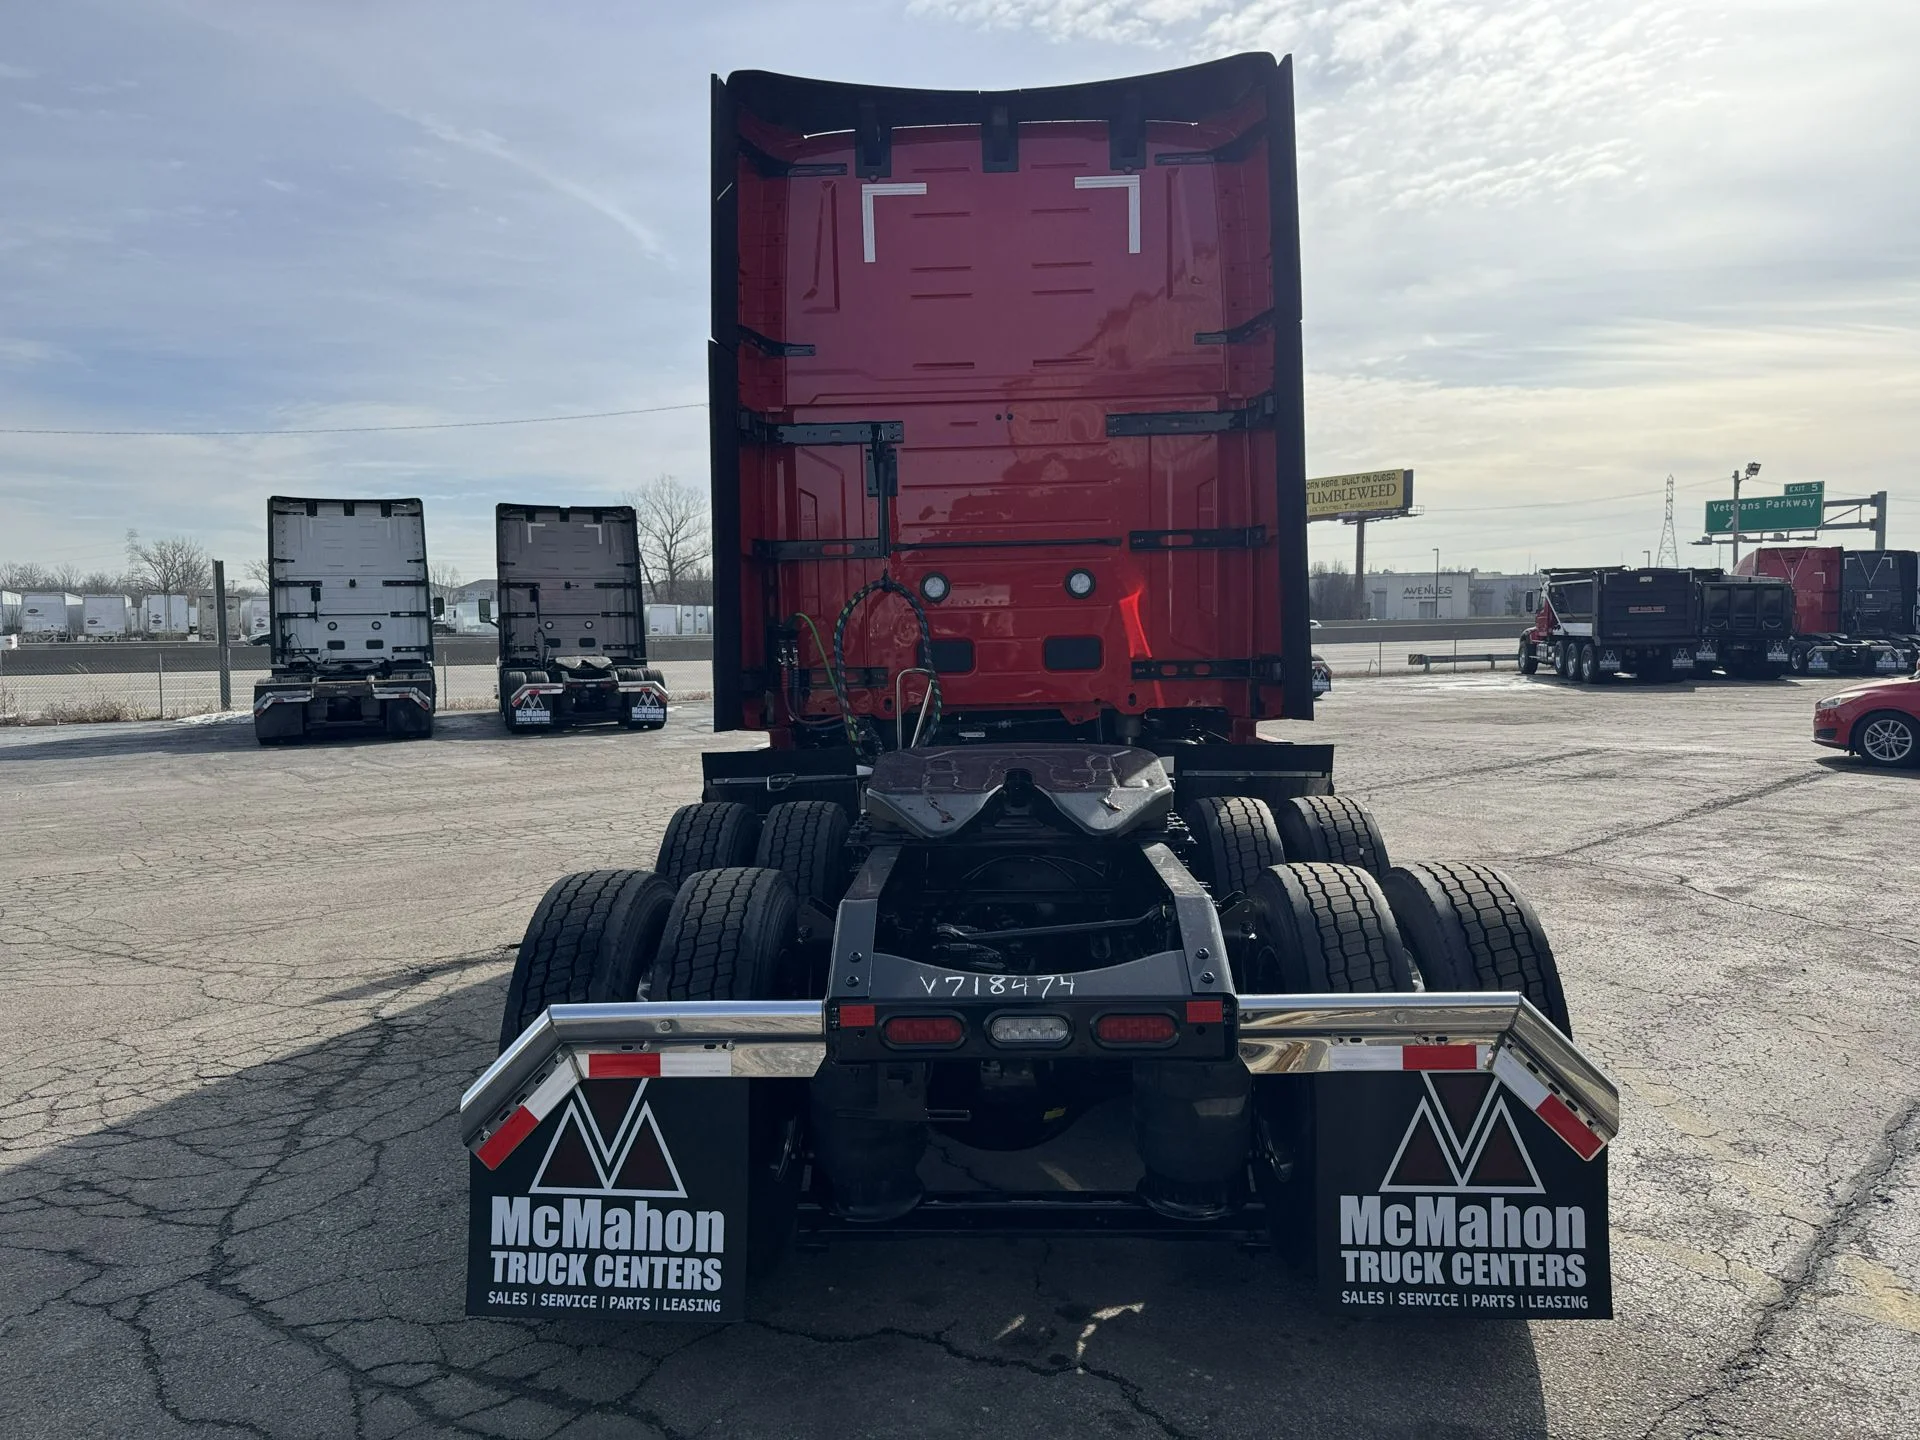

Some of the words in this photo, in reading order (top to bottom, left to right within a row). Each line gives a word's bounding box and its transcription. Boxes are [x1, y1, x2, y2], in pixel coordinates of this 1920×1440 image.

[1306, 480, 1320, 490] ORN
[1341, 476, 1360, 486] BUILT
[1361, 475, 1371, 484] ON
[1789, 485, 1805, 493] EXIT
[1811, 483, 1818, 492] 5
[1306, 483, 1397, 505] TUMBLEWEED
[1765, 498, 1816, 509] Parkway
[515, 709, 551, 717] McMahon
[631, 706, 665, 714] McMahon
[919, 975, 1075, 999] V718474
[490, 1195, 725, 1254] McMahon
[1339, 1195, 1586, 1249] McMahon
[490, 1250, 589, 1287] TRUCK
[593, 1253, 723, 1292] CENTERS
[1340, 1250, 1446, 1285] TRUCK
[1451, 1251, 1587, 1288] CENTERS
[487, 1290, 528, 1306] SALES
[540, 1293, 598, 1309] SERVICE
[608, 1295, 651, 1311] PARTS
[662, 1297, 721, 1313] LEASING
[1341, 1290, 1385, 1305] SALES
[1398, 1291, 1459, 1308] SERVICE
[1471, 1294, 1515, 1309] PARTS
[1527, 1295, 1589, 1310] LEASING
